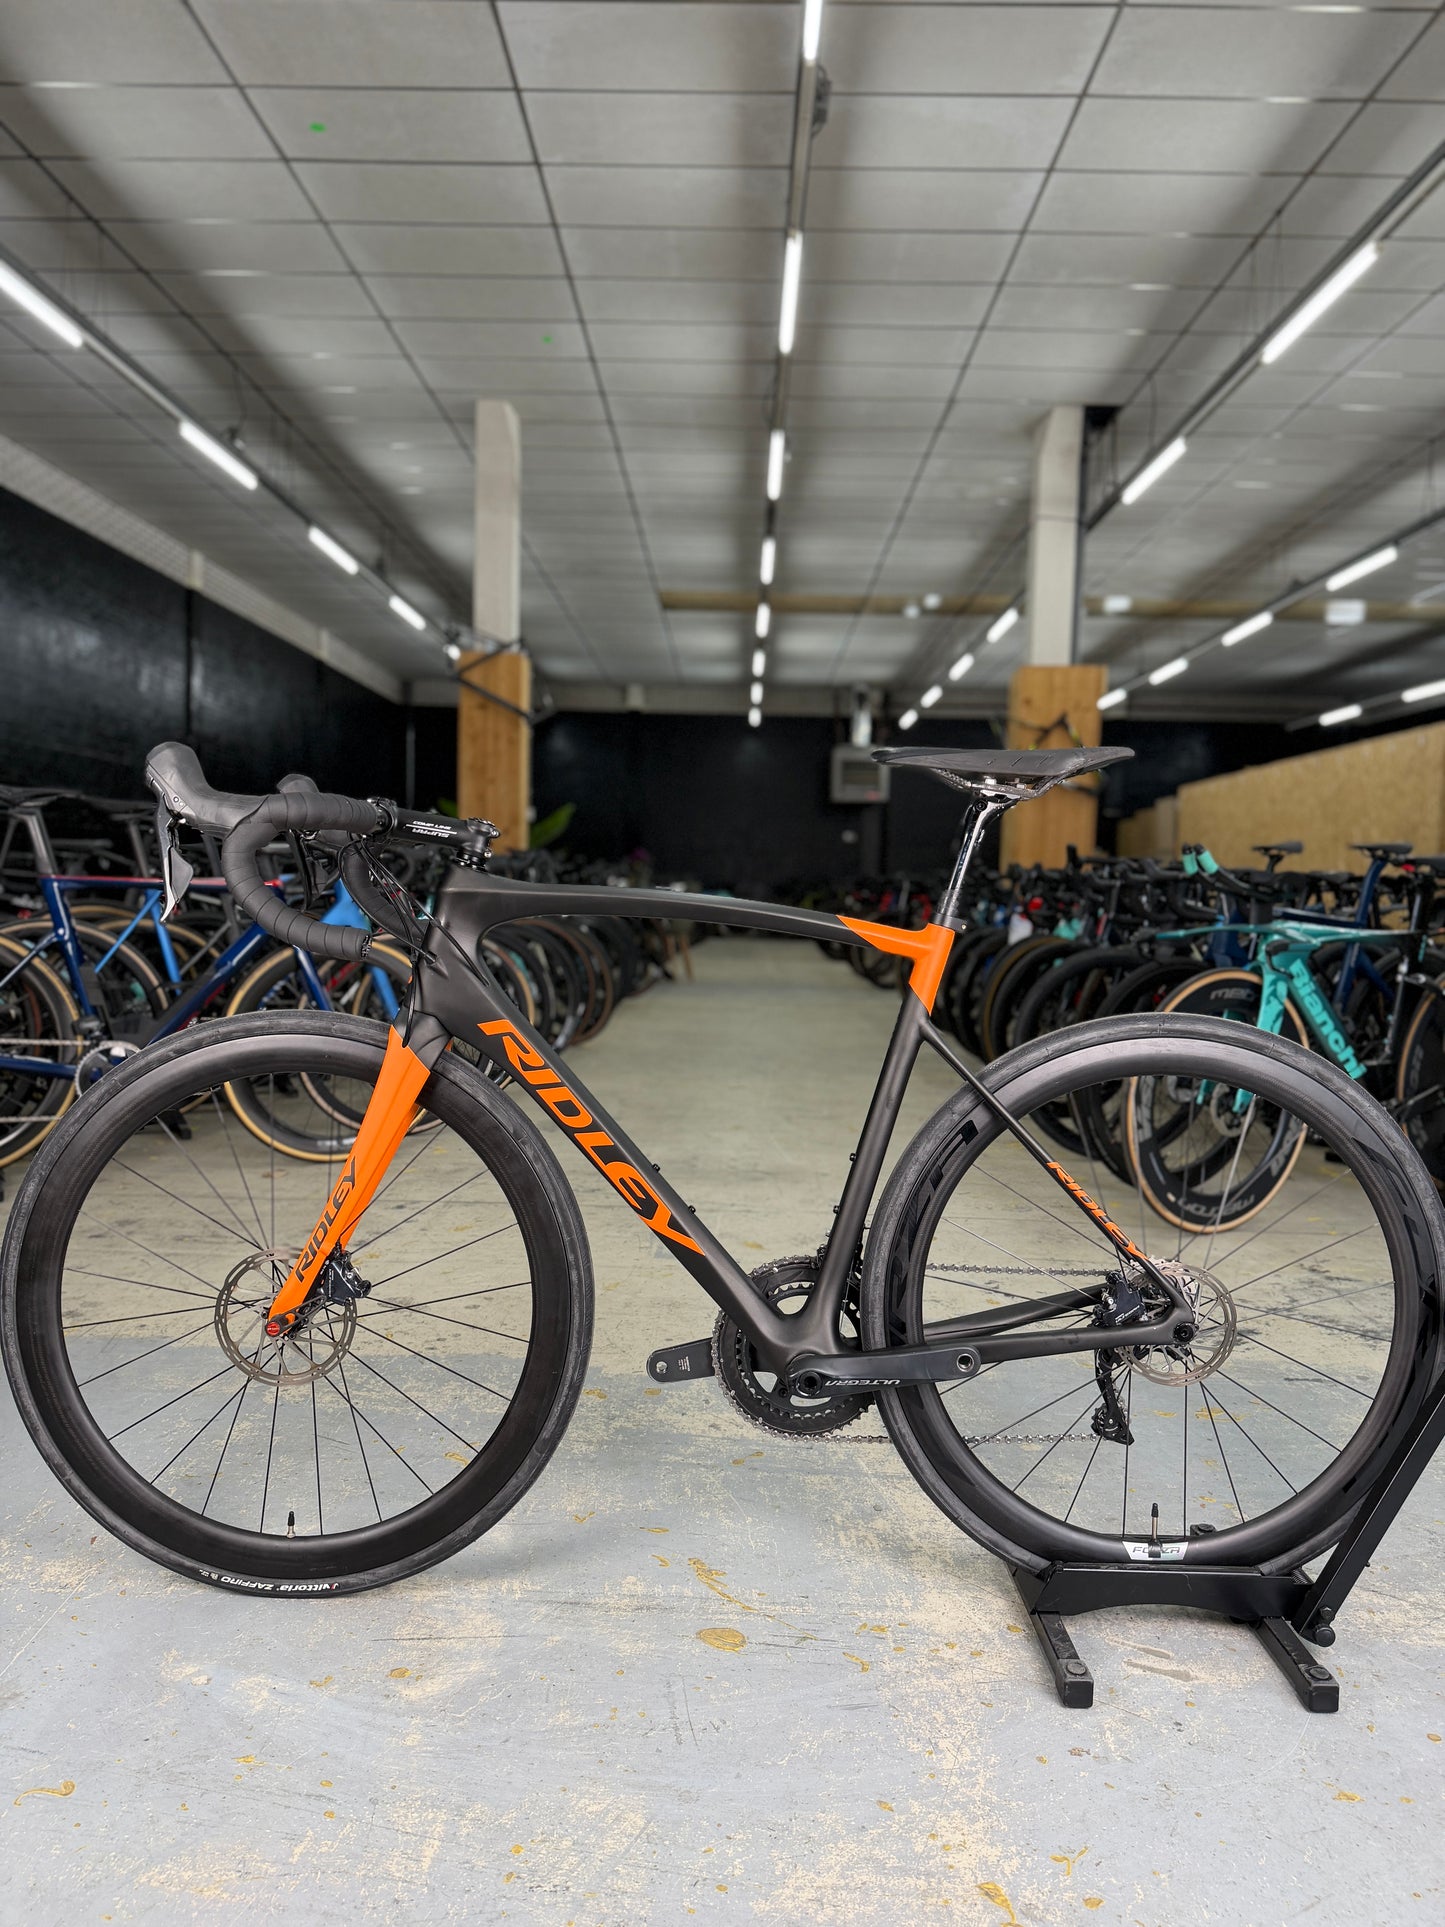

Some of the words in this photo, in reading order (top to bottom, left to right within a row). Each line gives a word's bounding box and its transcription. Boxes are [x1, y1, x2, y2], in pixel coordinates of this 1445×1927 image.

[411, 828, 450, 838] SUPRA
[1289, 958, 1368, 1080] Bianchi
[476, 1019, 706, 1257] RIDLEY
[295, 1156, 356, 1283] RIDLEY
[1046, 1161, 1150, 1260] RIDLEY
[220, 1575, 275, 1591] ZAFFIRO
[1132, 1545, 1181, 1555] FOZA
